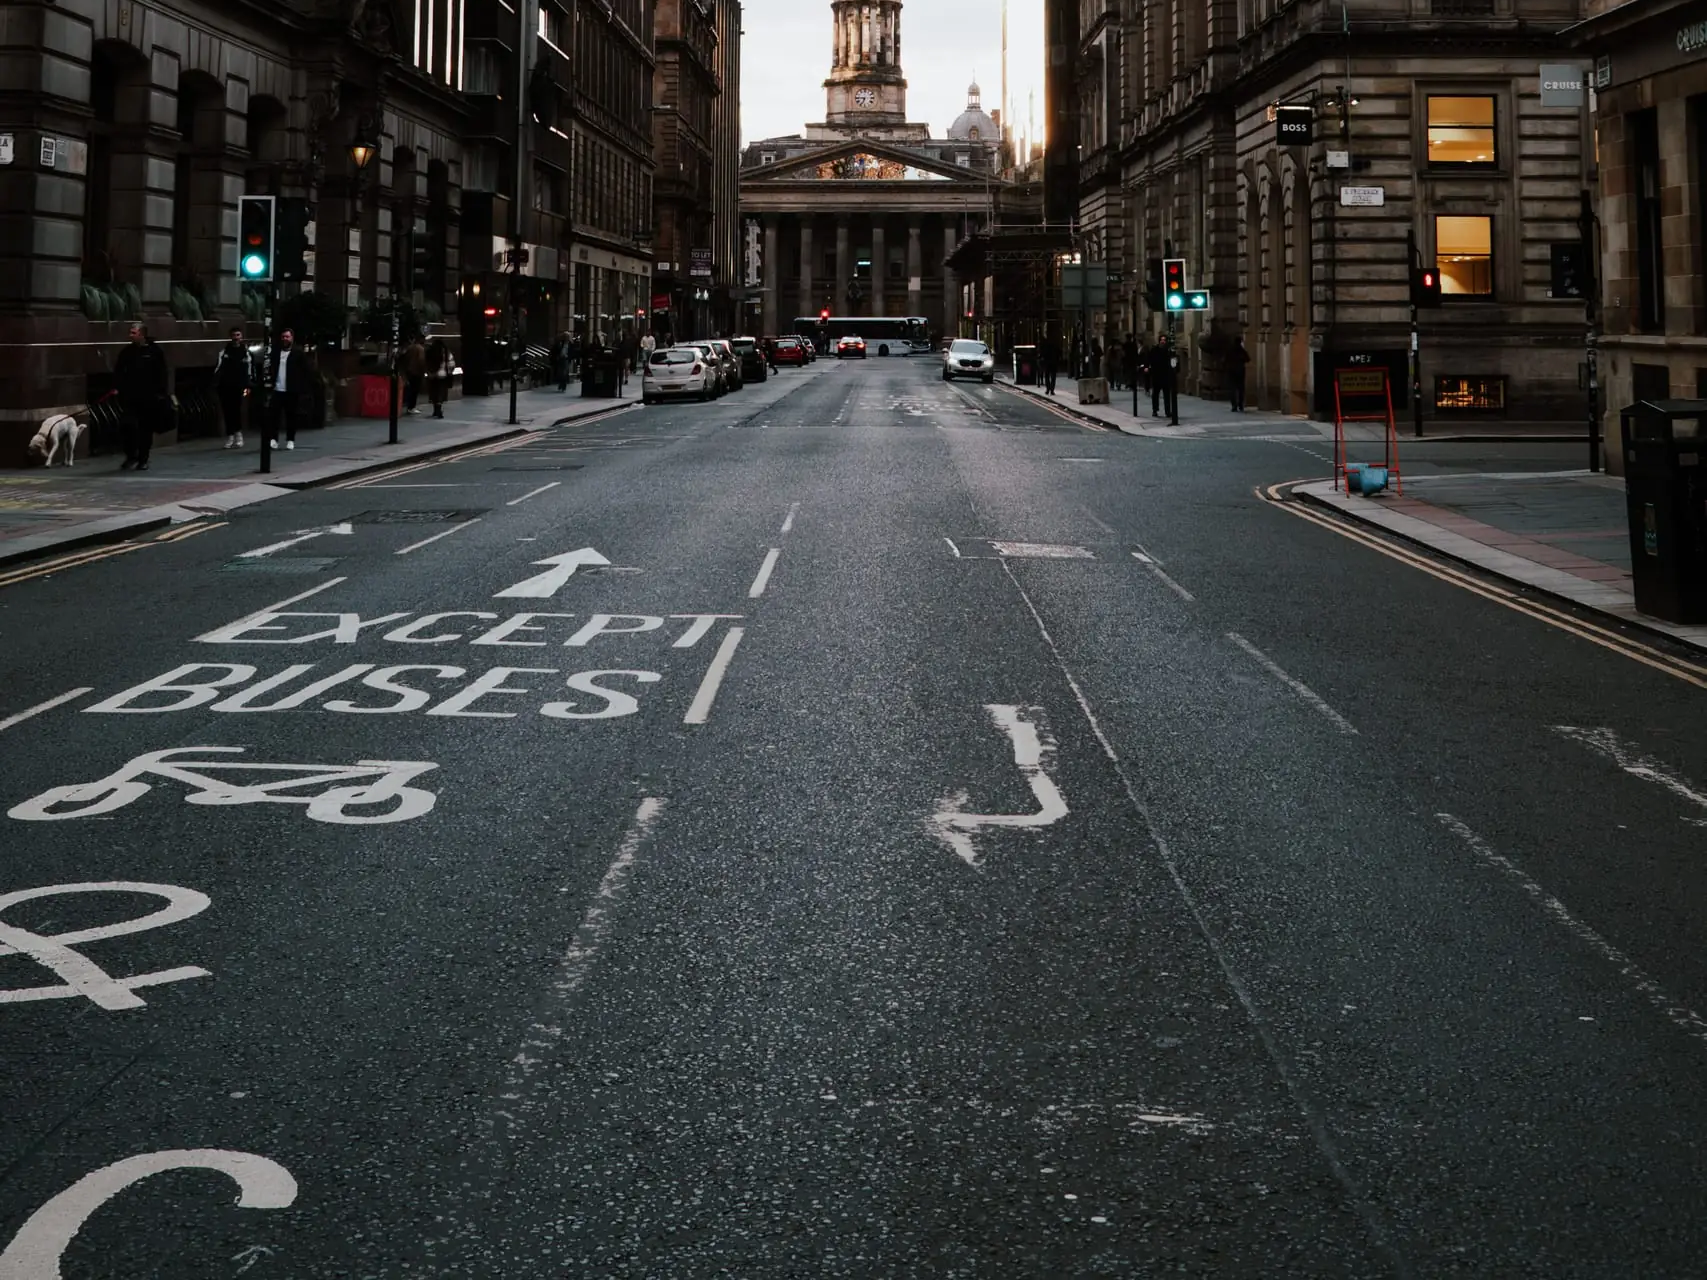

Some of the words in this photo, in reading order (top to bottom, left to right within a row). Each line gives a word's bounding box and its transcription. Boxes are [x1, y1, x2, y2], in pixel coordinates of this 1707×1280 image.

[1677, 21, 1707, 51] CRUIS
[1544, 81, 1582, 90] CRUISE
[1282, 123, 1307, 131] BOSS
[202, 611, 744, 648] EXCEPT
[80, 662, 662, 719] BUSES
